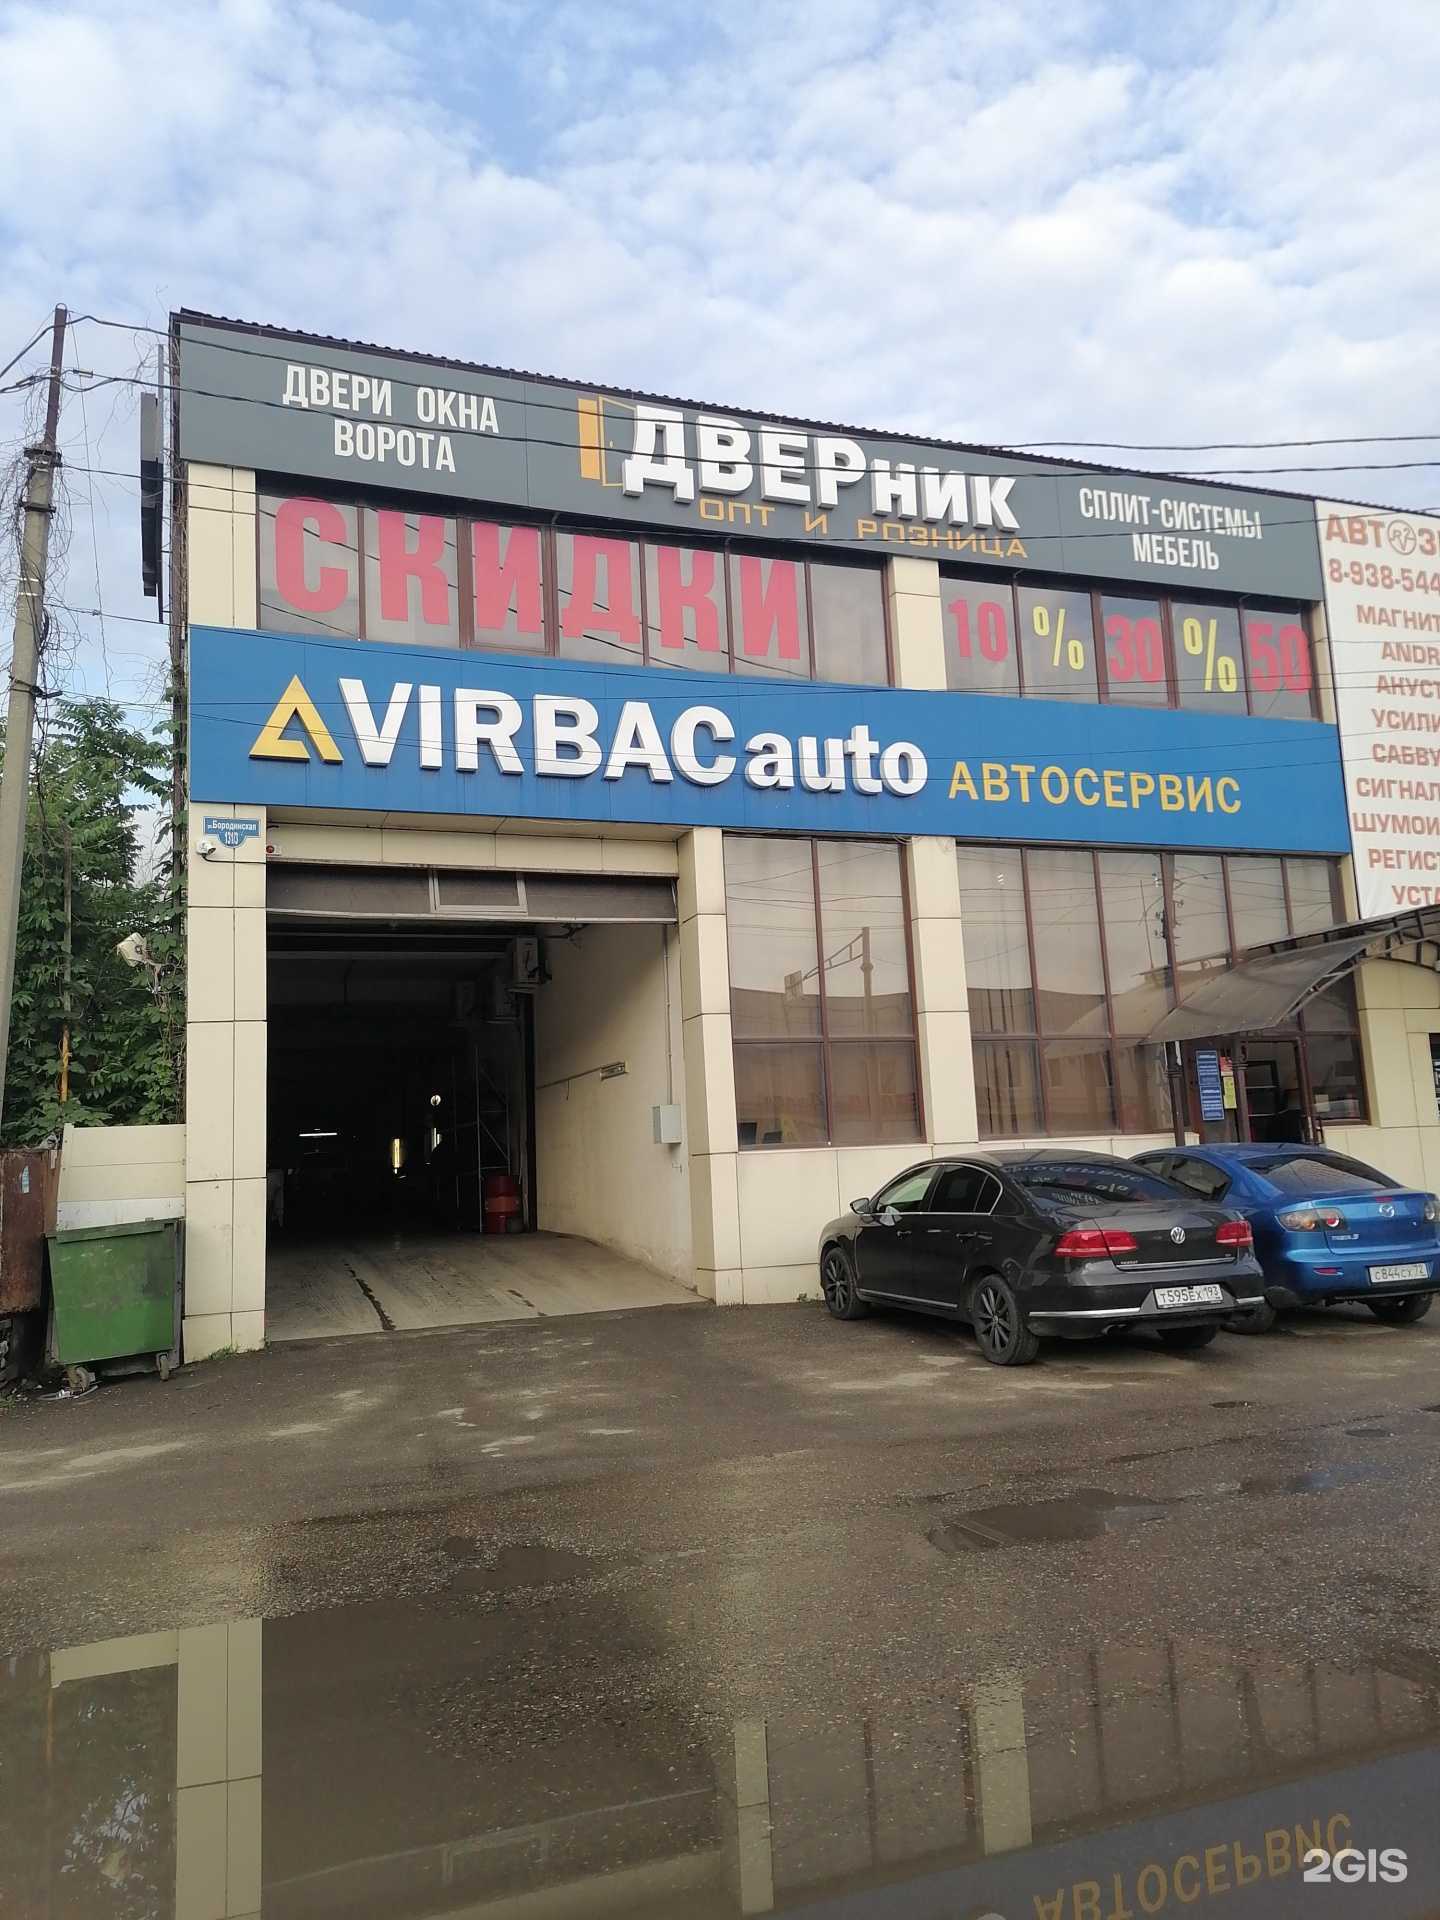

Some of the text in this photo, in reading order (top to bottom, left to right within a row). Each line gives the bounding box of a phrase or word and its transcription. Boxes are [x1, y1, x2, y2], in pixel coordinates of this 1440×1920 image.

[282, 364, 499, 434] ДВЕРИ ОКНА
[334, 419, 456, 473] ВОРОТА
[699, 498, 1028, 559] ОПТ И РОЗНИЦА
[1079, 487, 1263, 540] СПЛИТ-СИСТЕМЫ
[275, 496, 801, 660] СКИДКИ
[1133, 533, 1220, 571] МЕБЕЛЬ
[948, 600, 1009, 663] 10
[1105, 615, 1165, 683] 30
[1247, 623, 1313, 695] 50
[949, 761, 1241, 813] АВТОСЕРВИС
